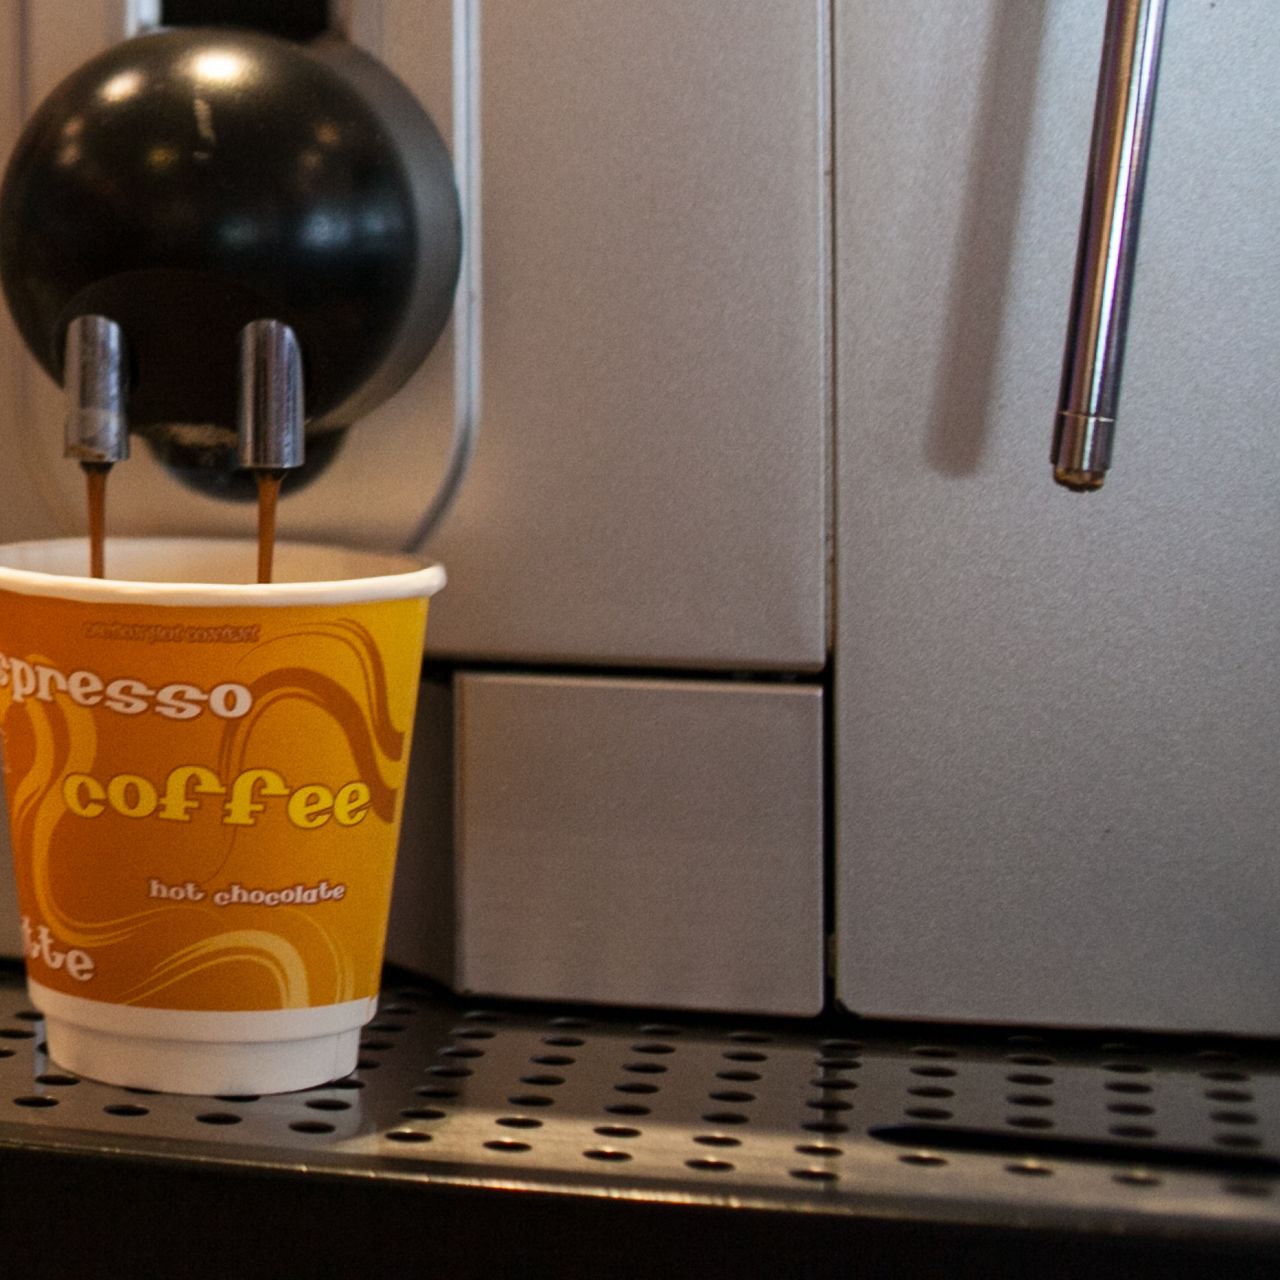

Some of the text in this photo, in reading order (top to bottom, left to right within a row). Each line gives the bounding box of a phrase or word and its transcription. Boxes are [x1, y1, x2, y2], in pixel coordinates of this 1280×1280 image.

[62, 765, 371, 830] coffee
[148, 878, 346, 907] hot chocolate
